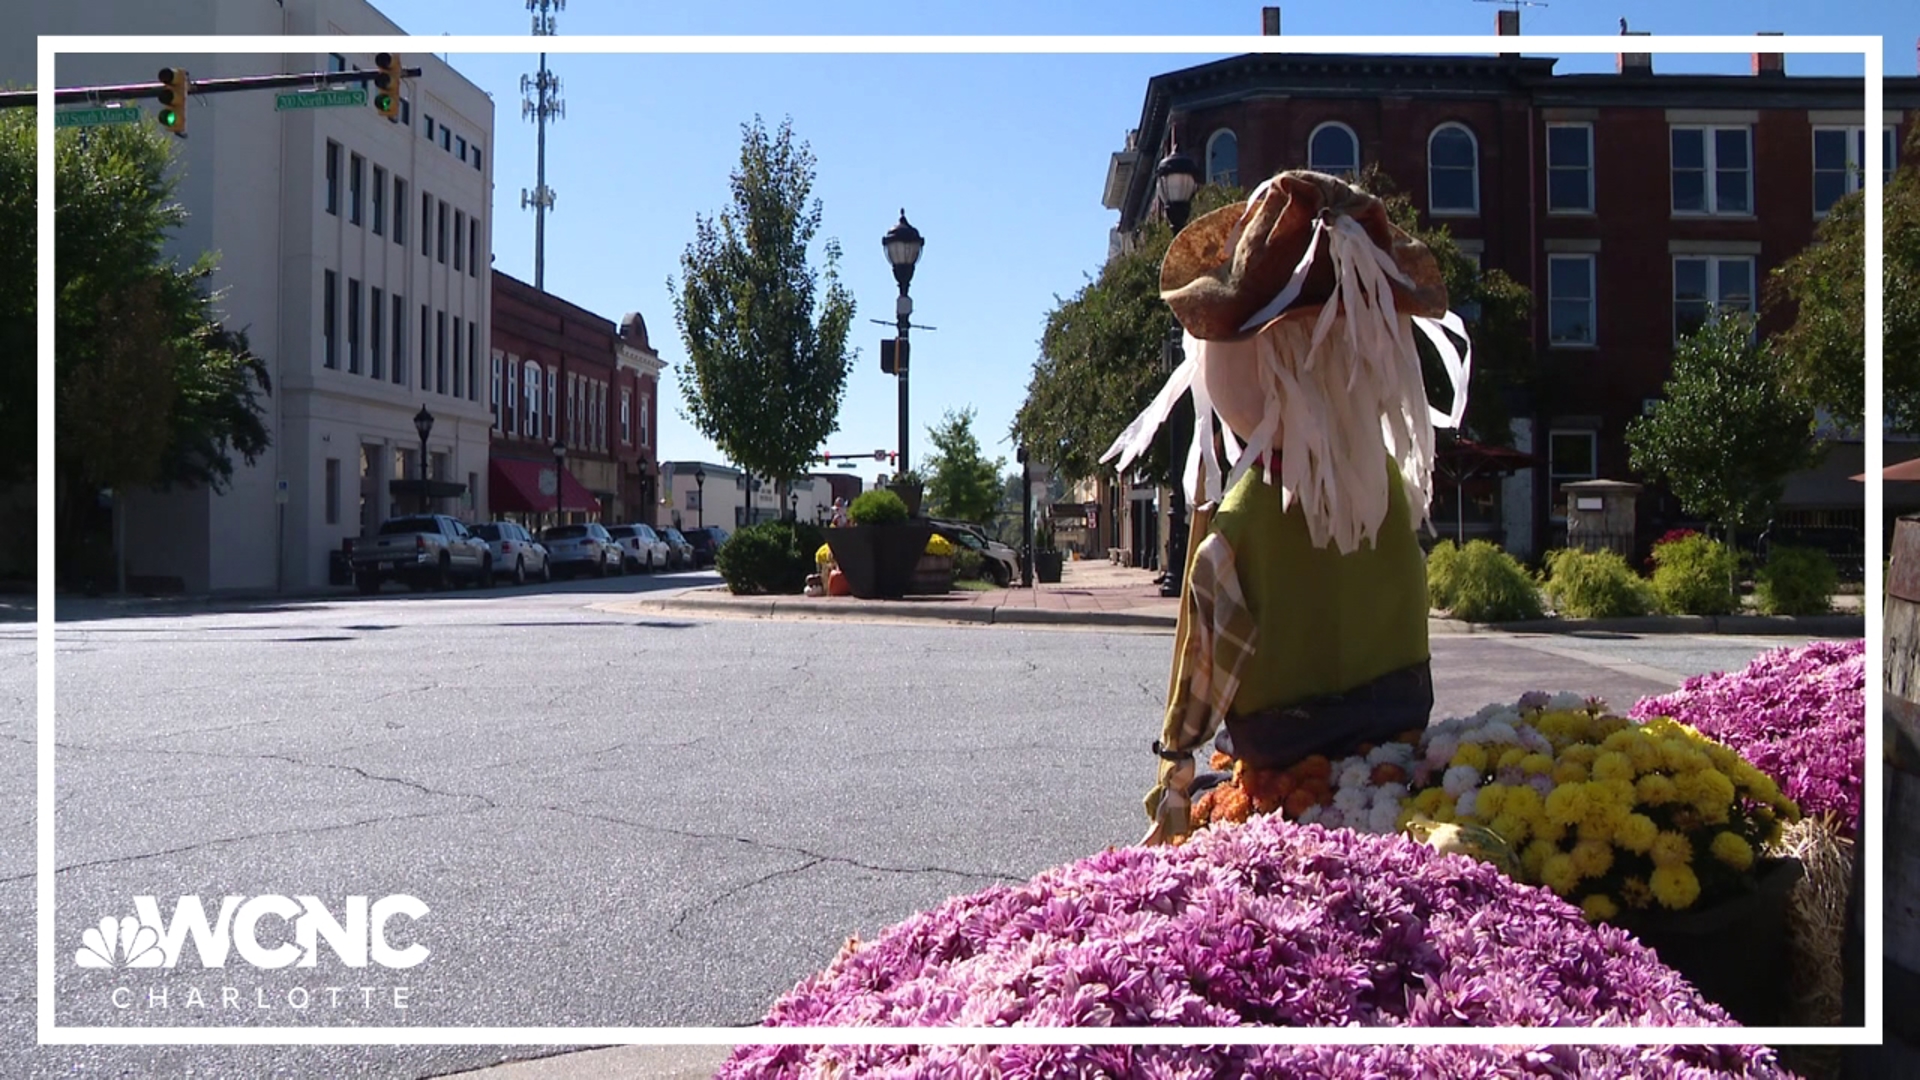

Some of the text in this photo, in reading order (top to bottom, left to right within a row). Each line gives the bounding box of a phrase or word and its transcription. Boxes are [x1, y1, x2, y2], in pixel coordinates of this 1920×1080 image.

[280, 92, 362, 108] 200 North Main St
[70, 110, 98, 124] South
[100, 110, 124, 121] Main
[126, 109, 136, 121] St
